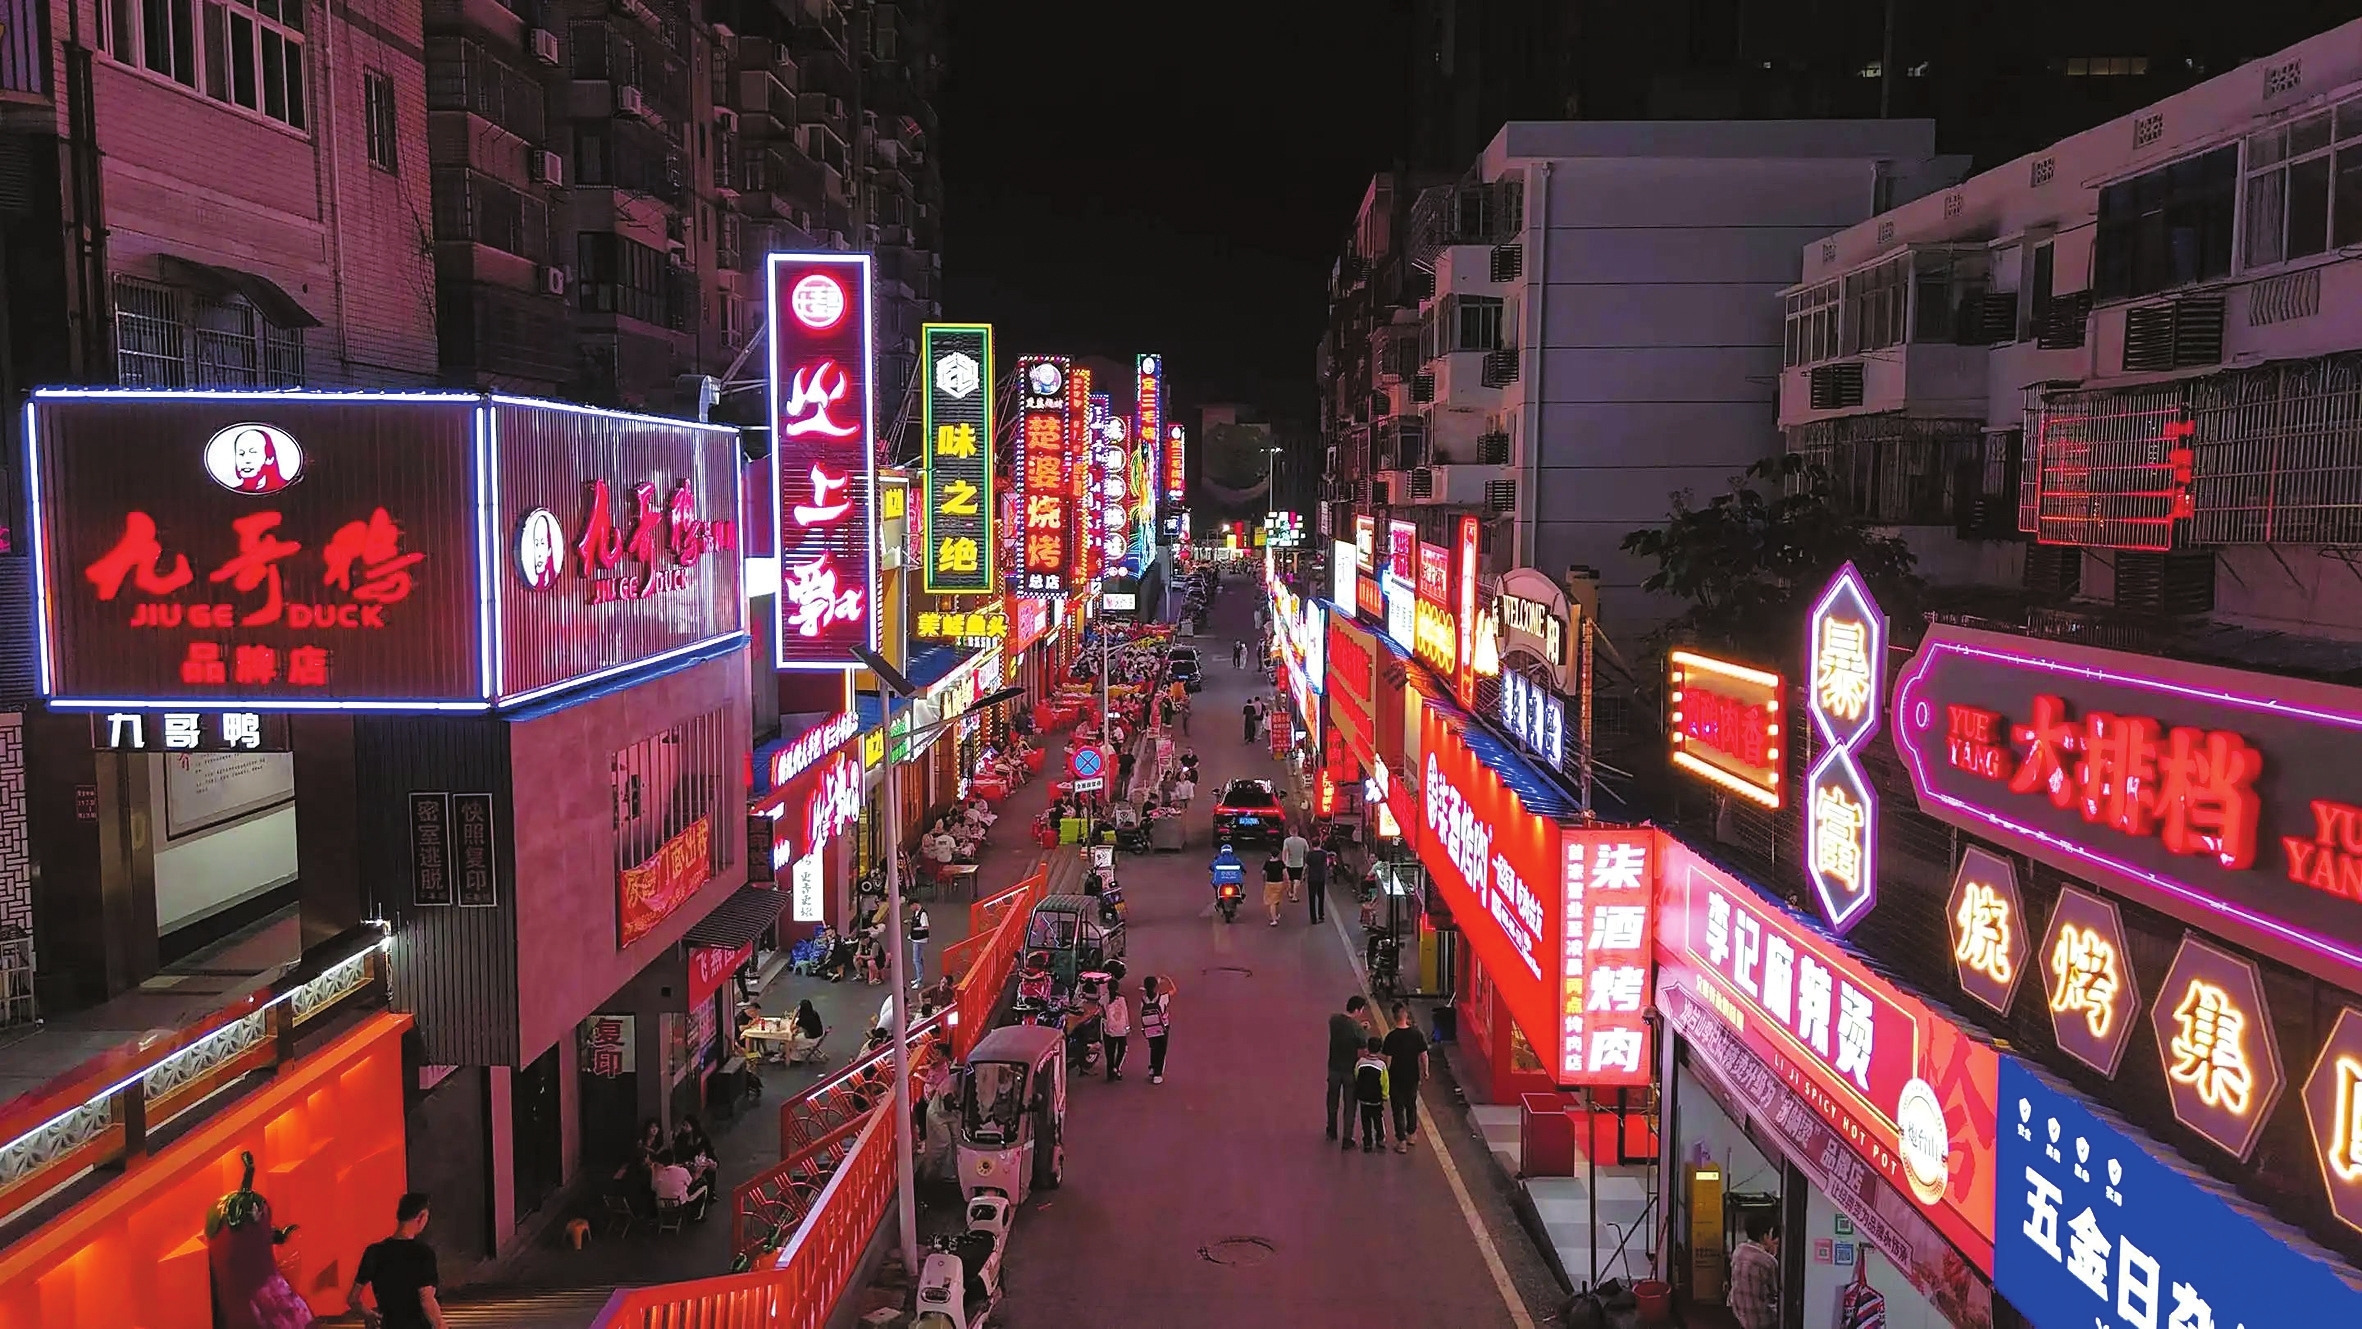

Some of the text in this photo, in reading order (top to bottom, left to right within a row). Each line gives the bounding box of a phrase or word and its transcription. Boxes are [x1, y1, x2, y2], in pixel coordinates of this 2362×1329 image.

[937, 423, 979, 573] 味之绝
[1027, 416, 1062, 568] 楚婆烧烤
[85, 507, 427, 627] 九哥鸭
[1028, 574, 1060, 590] 总店
[288, 604, 384, 629] DUCK
[917, 612, 1008, 638] 美蛙鱼头
[1503, 594, 1545, 639] WELCOME
[181, 642, 329, 686] 品牌店
[107, 713, 261, 748] 九哥鸭
[1947, 705, 1992, 743] YUE
[1947, 736, 2001, 779] YANG
[2009, 695, 2263, 870] 大排档
[417, 801, 443, 890] 密室逃脱
[461, 801, 487, 891] 快照复印
[1588, 844, 1646, 1072] 柒酒烤肉
[1706, 891, 1874, 1091] 李记麻辣烫
[592, 1018, 623, 1078] 复印
[1774, 1054, 1898, 1175] LI JI SPICY HOT POT
[1820, 1138, 1865, 1194] 品牌店
